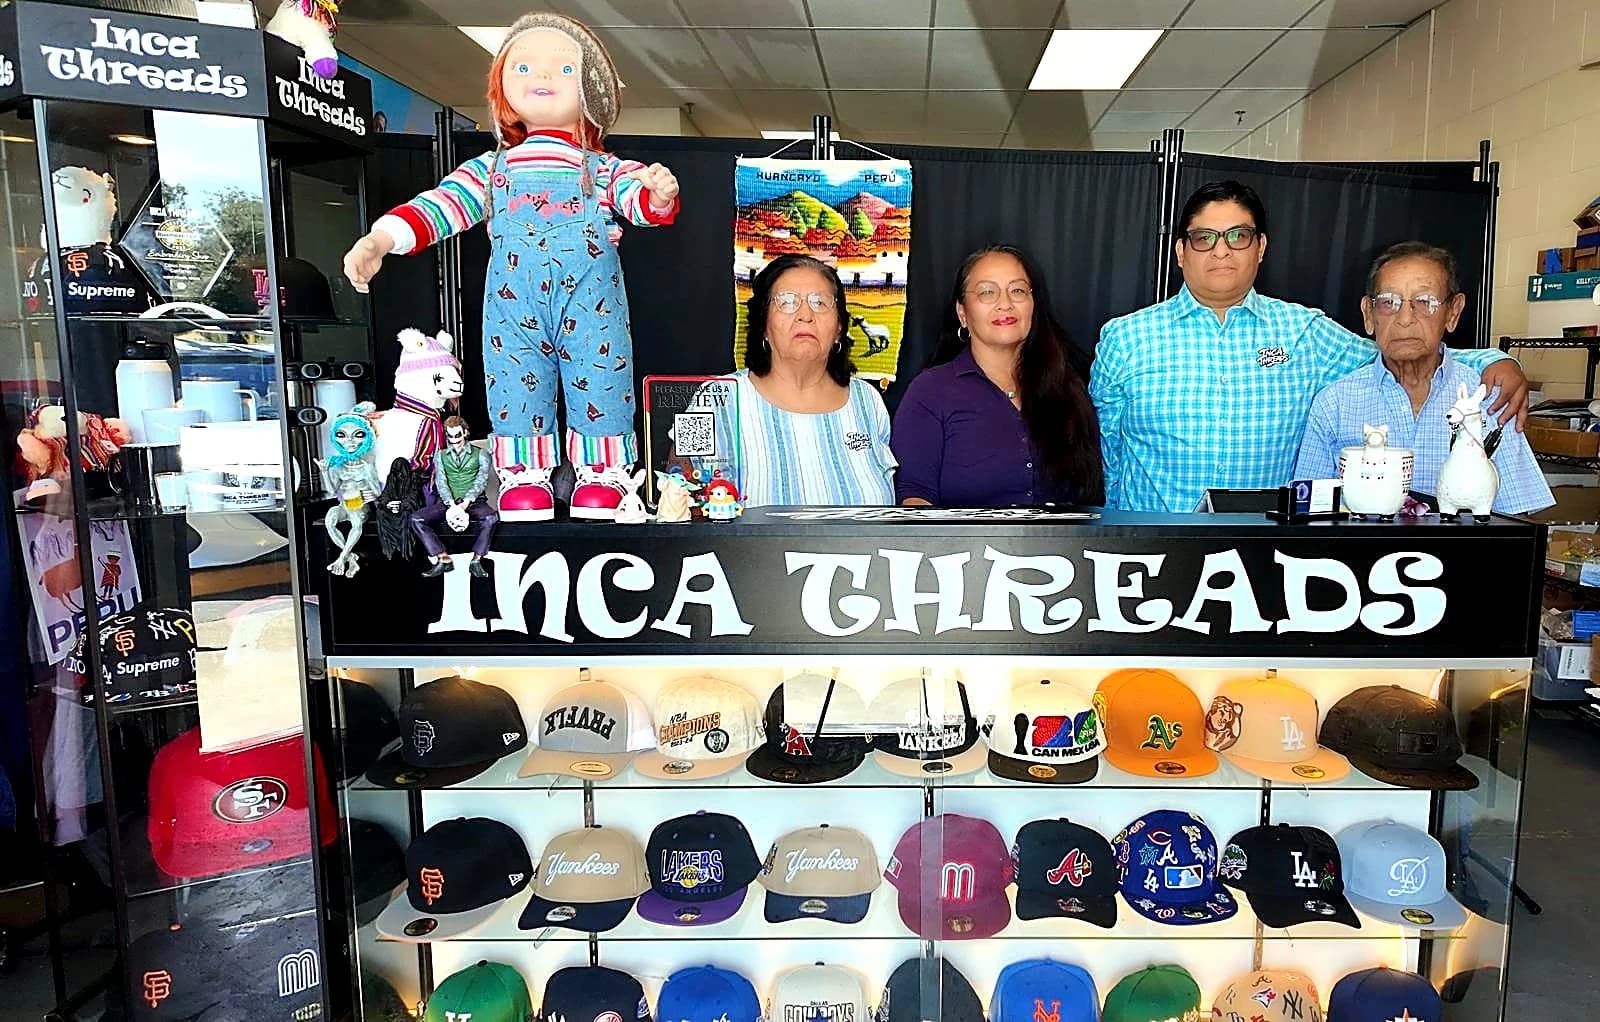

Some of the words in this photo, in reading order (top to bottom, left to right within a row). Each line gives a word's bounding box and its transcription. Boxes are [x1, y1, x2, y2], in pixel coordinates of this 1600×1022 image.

[90, 18, 200, 59] Inca
[41, 45, 248, 98] Threads
[275, 76, 366, 135] Threads
[756, 171, 821, 183] HUANCAYO
[864, 170, 896, 183] PERÚ
[68, 282, 135, 300] Supreme
[656, 395, 727, 408] REVIEW
[712, 385, 723, 393] US
[724, 385, 730, 393] A
[428, 552, 754, 640] INCA
[785, 546, 1448, 637] THREADS
[117, 656, 180, 677] Supreme
[670, 711, 687, 724] NBA
[1032, 748, 1060, 757] CAN
[1062, 745, 1084, 757] MEX
[545, 851, 620, 886] Yankees
[661, 849, 724, 883] LAKERS
[785, 848, 859, 883] Yankees
[1291, 851, 1319, 888] LA
